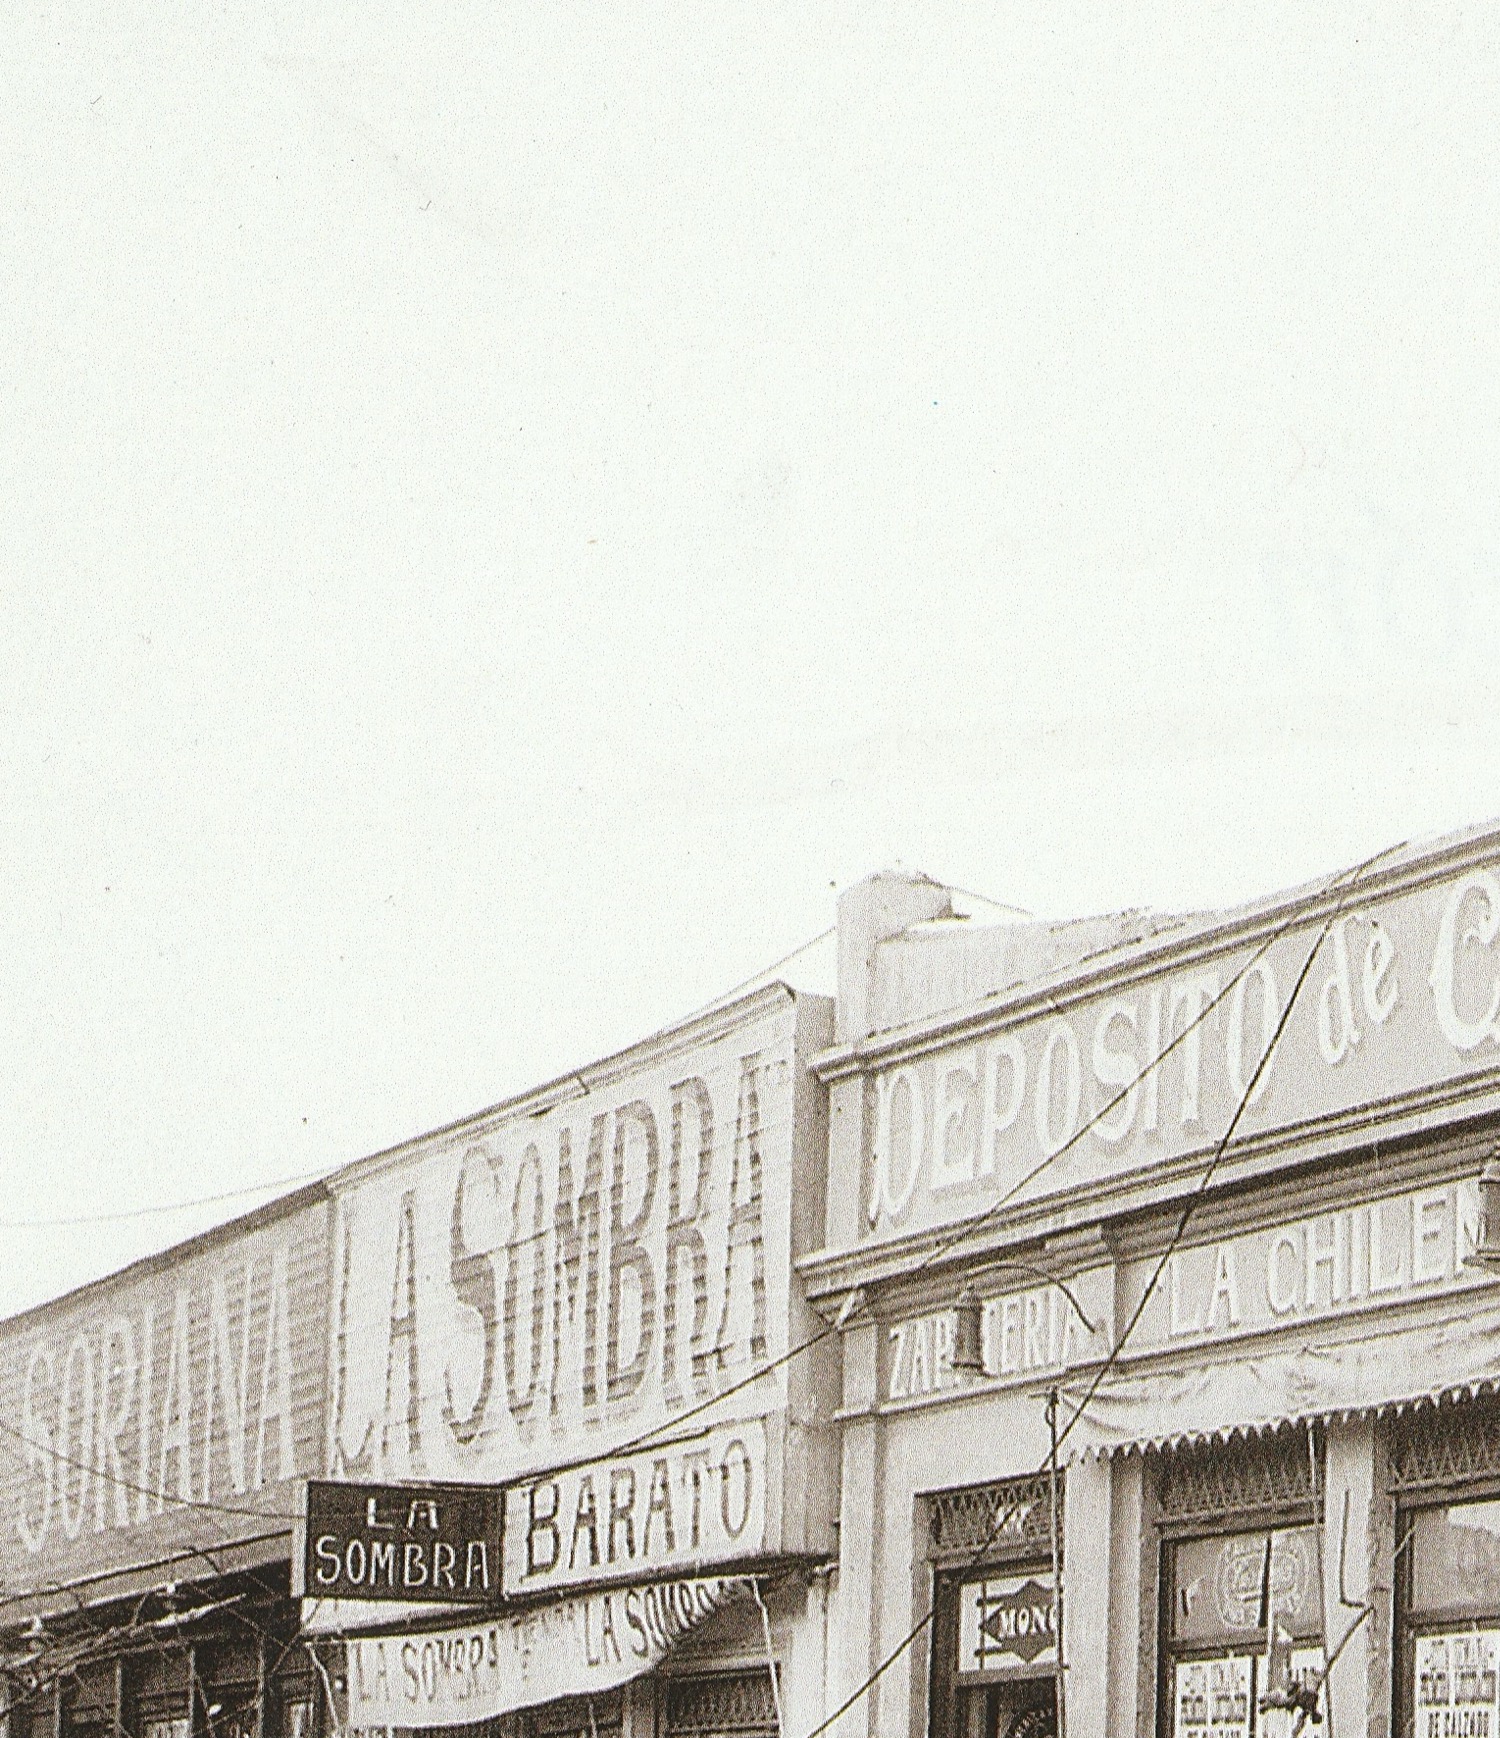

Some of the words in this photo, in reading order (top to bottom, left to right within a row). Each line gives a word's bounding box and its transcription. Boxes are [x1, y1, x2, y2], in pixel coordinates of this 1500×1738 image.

[870, 962, 1277, 1225] DEPOSITO
[1317, 912, 1400, 1066] de
[443, 1052, 774, 1447] SOMBRA
[315, 1535, 490, 1590] SOMBRA
[366, 1497, 440, 1531] LA
[520, 1439, 752, 1584] BARATO
